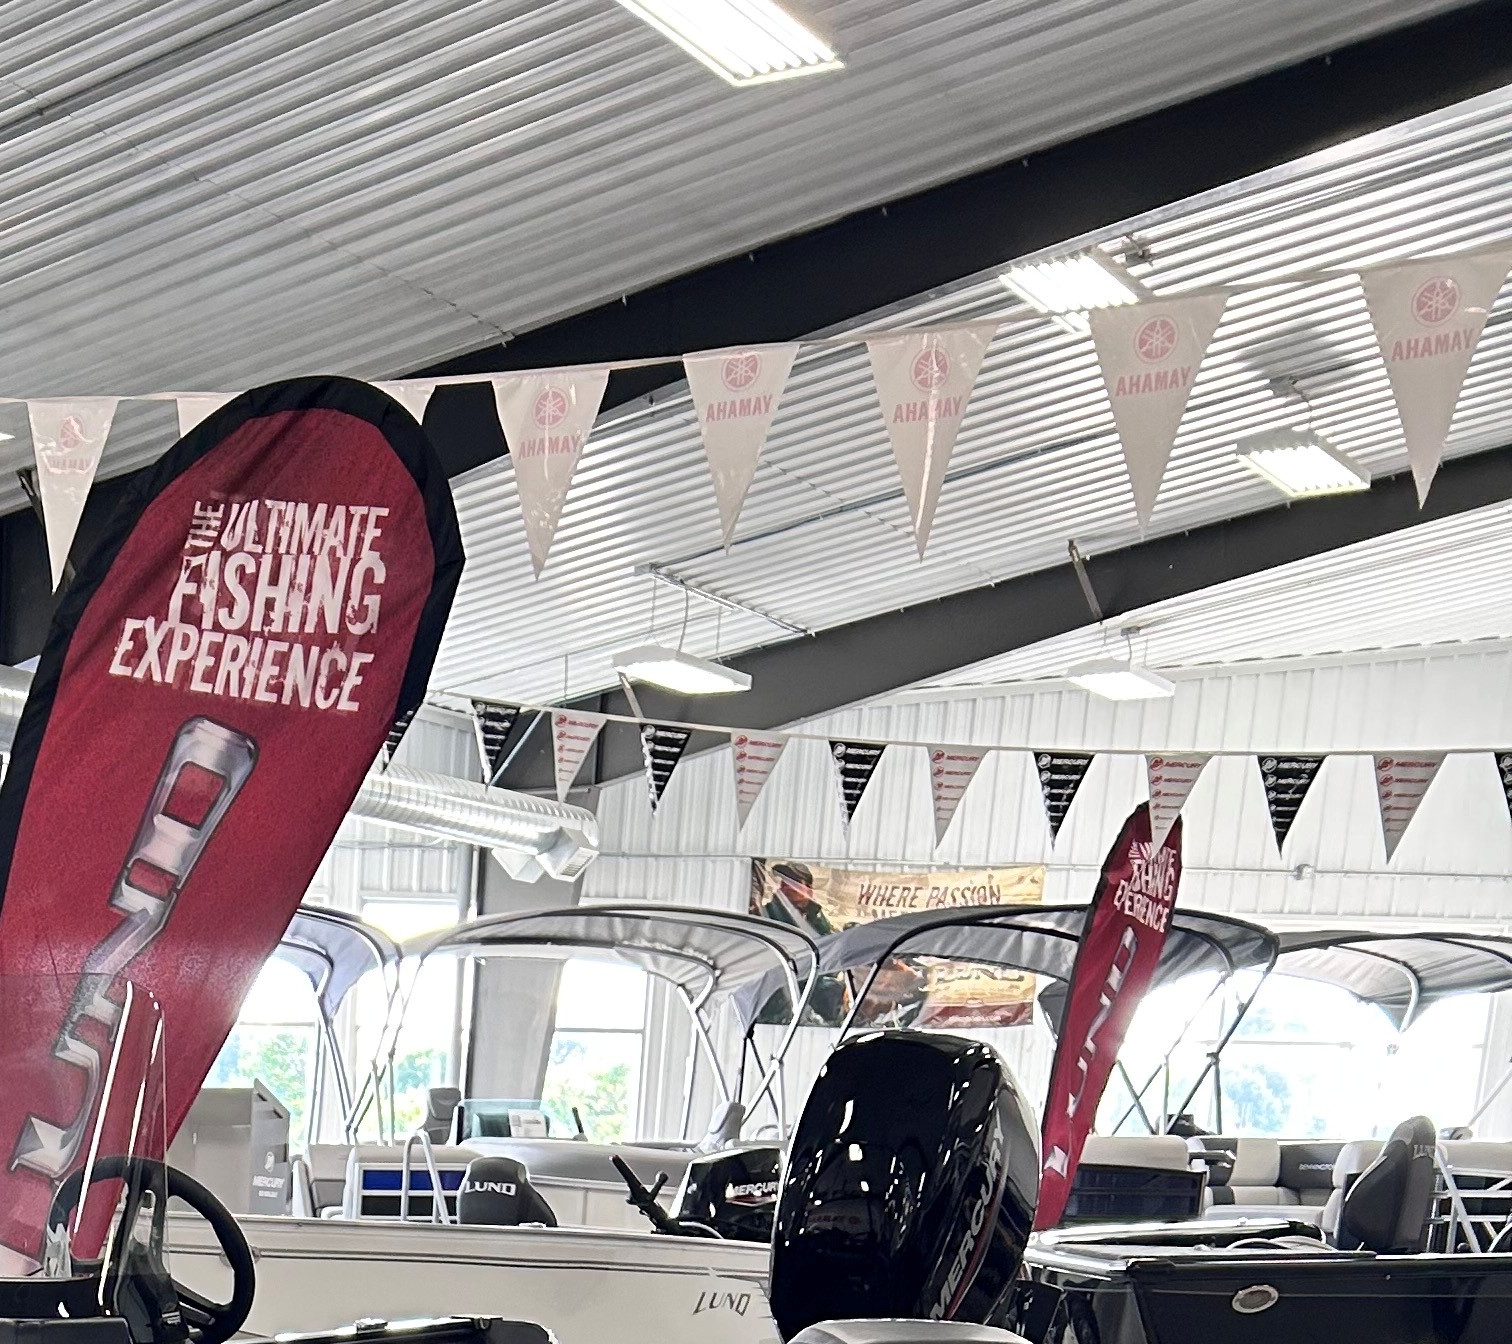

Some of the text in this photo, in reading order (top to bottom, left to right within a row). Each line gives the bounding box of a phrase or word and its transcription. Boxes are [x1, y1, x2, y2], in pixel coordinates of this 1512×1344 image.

[183, 499, 390, 560] THE ULTIMATE
[168, 550, 387, 635] FISHING
[108, 616, 375, 713] EXPERIENCE
[857, 883, 1002, 908] WHERE PASSION
[465, 1181, 517, 1196] LUND
[929, 1106, 1005, 1320] MERCURY
[692, 1291, 752, 1317] LUND
